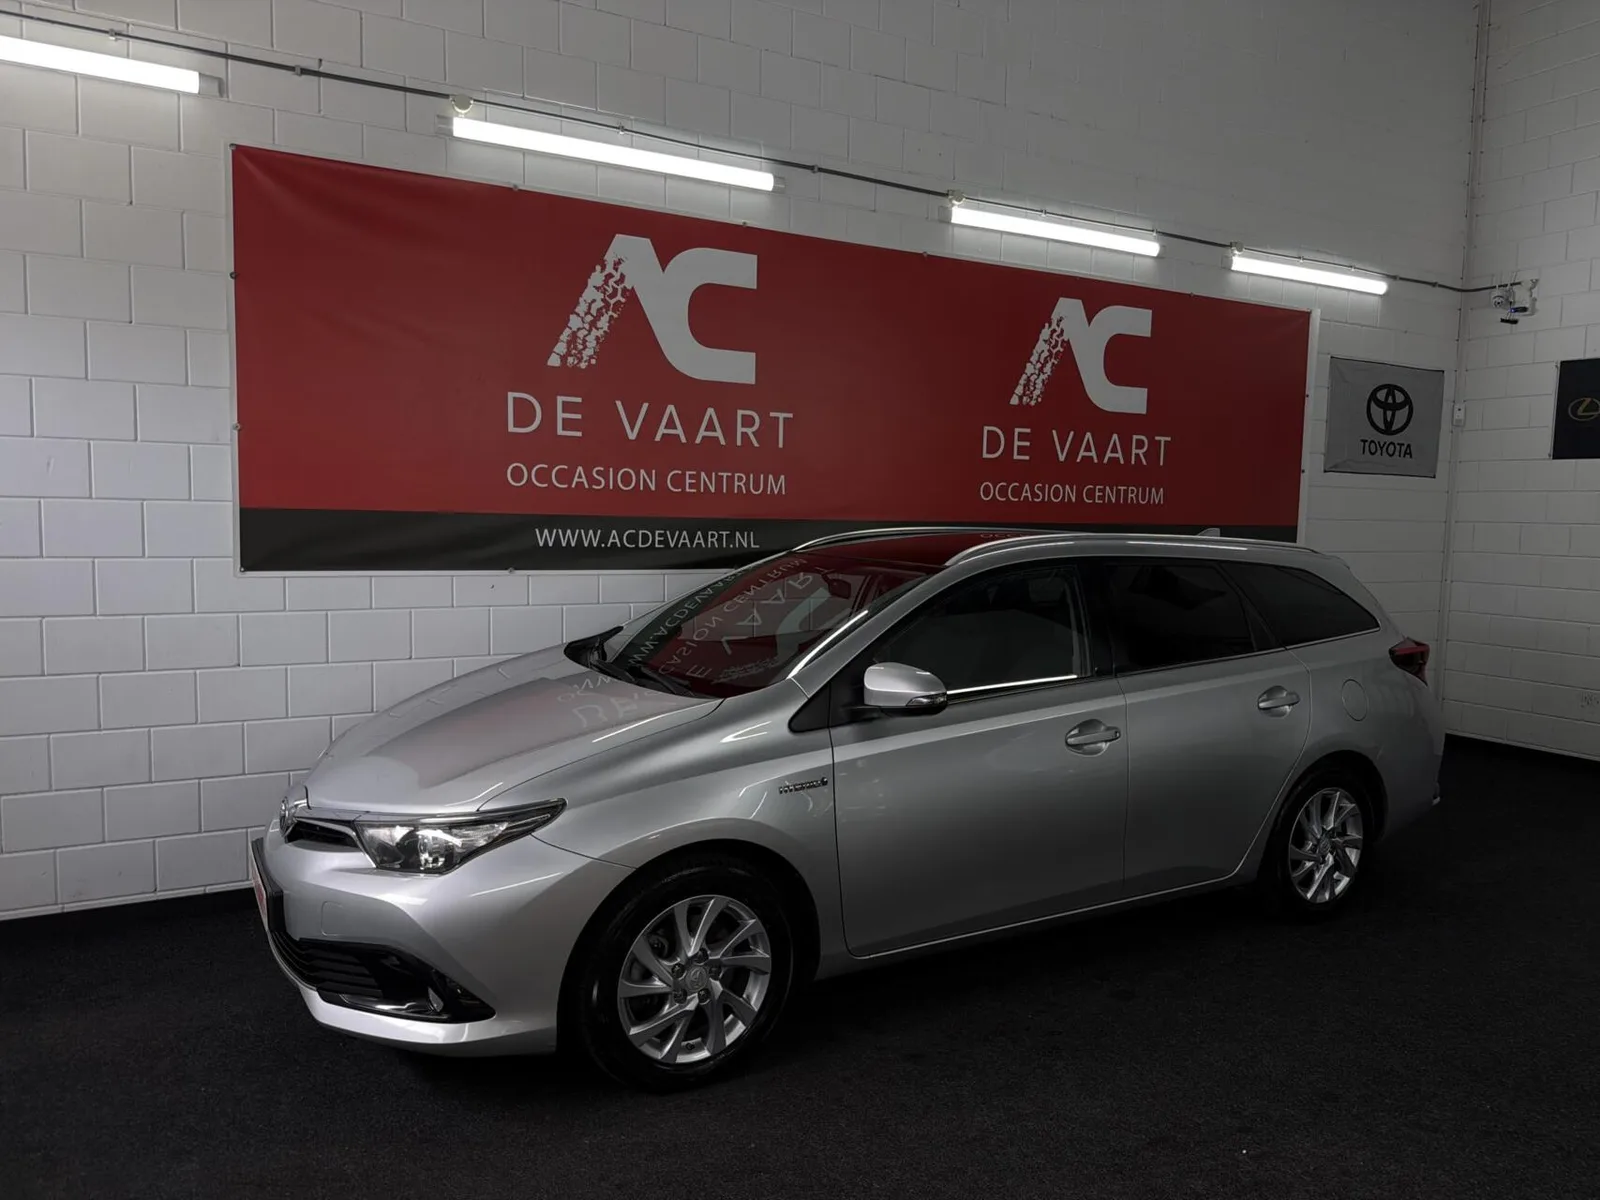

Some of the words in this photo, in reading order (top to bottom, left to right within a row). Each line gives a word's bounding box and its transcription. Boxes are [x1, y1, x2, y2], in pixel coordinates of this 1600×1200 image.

[547, 233, 758, 385] AC
[1009, 297, 1152, 415] AC
[507, 391, 583, 437] DE
[615, 400, 794, 449] VAART
[982, 425, 1031, 460] DE
[1052, 429, 1172, 466] VAART
[1359, 438, 1413, 459] TOYOTA
[506, 462, 656, 491] OCCASION
[666, 469, 786, 496] CENTRUM
[980, 481, 1076, 503] OCCASION
[1083, 484, 1164, 505] CENTRUM
[535, 528, 760, 549] WWW.ACDEVAART.NL
